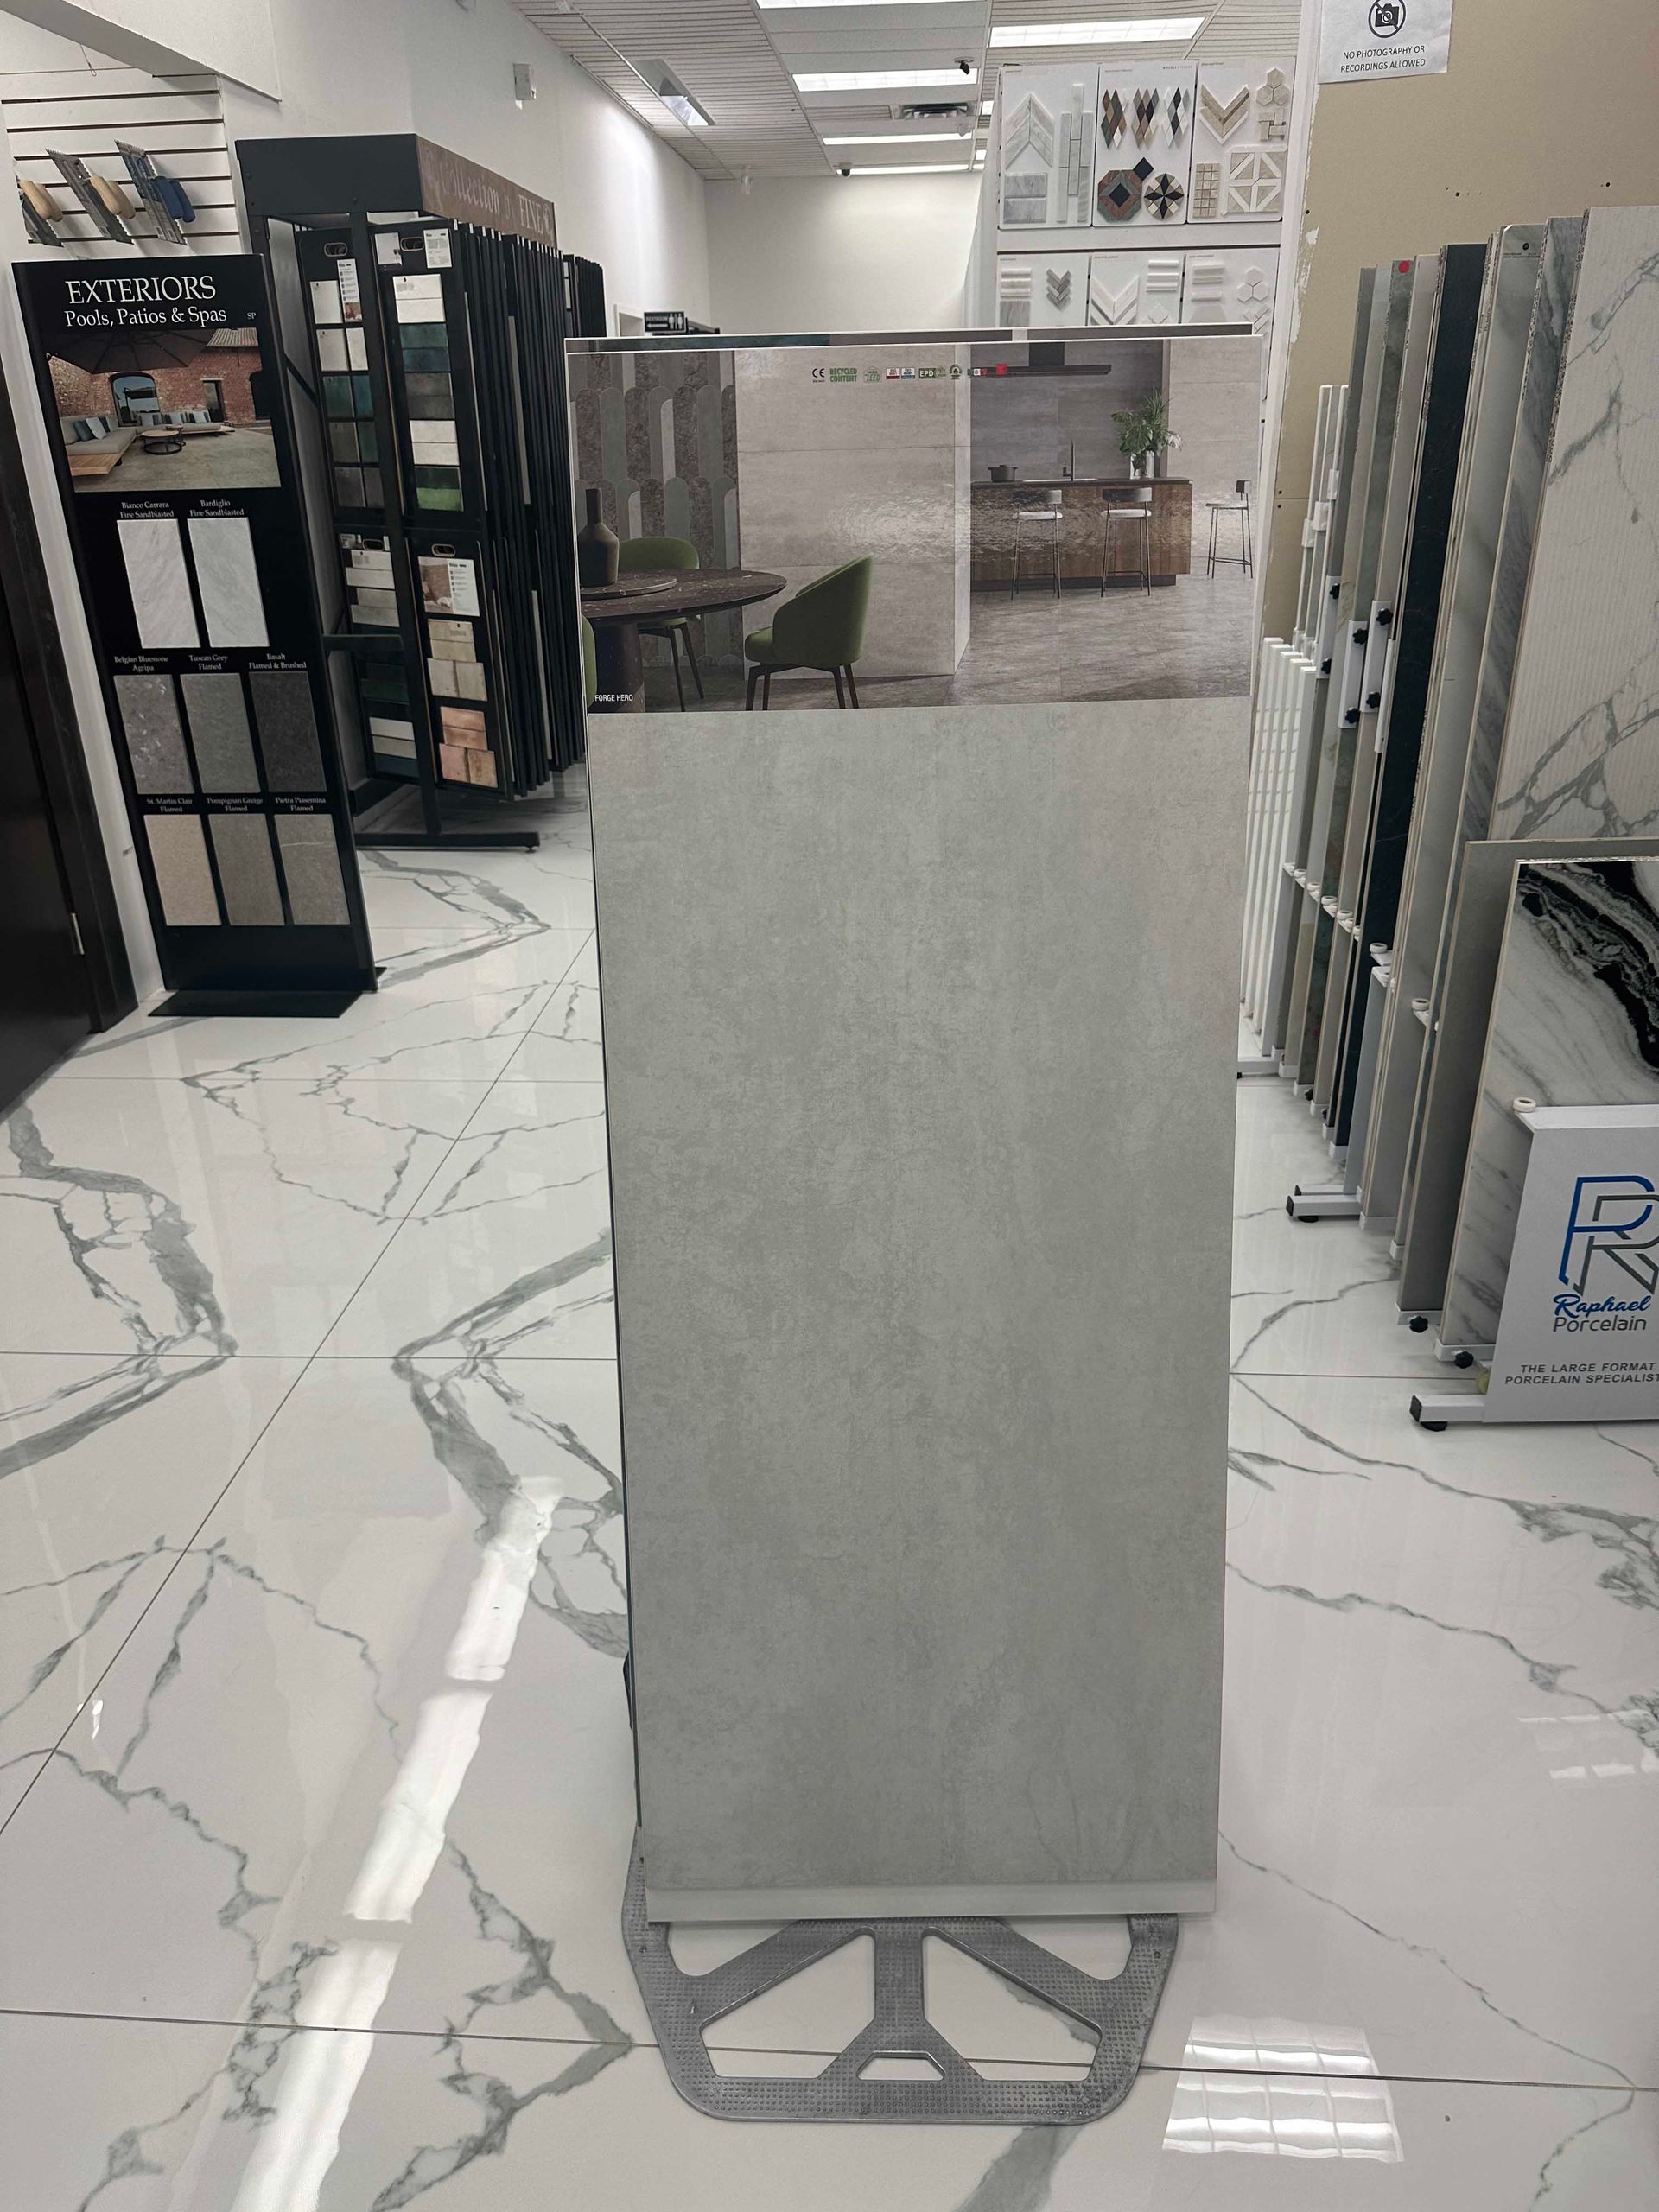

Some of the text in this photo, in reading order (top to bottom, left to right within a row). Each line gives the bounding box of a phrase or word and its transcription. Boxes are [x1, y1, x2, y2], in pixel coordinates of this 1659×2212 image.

[1343, 45, 1425, 60] NO PHOTOGRAPHY OR
[1340, 59, 1426, 73] RECORDINGS ALLOWED
[65, 275, 217, 304] EXTERIORS
[64, 309, 114, 328] Pools,
[117, 308, 167, 326] Patios
[171, 306, 186, 323] &
[188, 305, 227, 327] Spas
[121, 501, 143, 510] Bianco
[200, 499, 231, 508] Bardiglio
[205, 508, 245, 517] Sandblasted
[114, 656, 137, 664] Belgian
[280, 661, 307, 670] Brushed
[594, 693, 633, 702] FORGE HERO
[1552, 1294, 1652, 1319] Raphael
[1553, 1315, 1647, 1332] Porcelain
[1521, 1362, 1656, 1373] THE LARGE FORMAT
[1504, 1375, 1580, 1384] PORCELAIN
